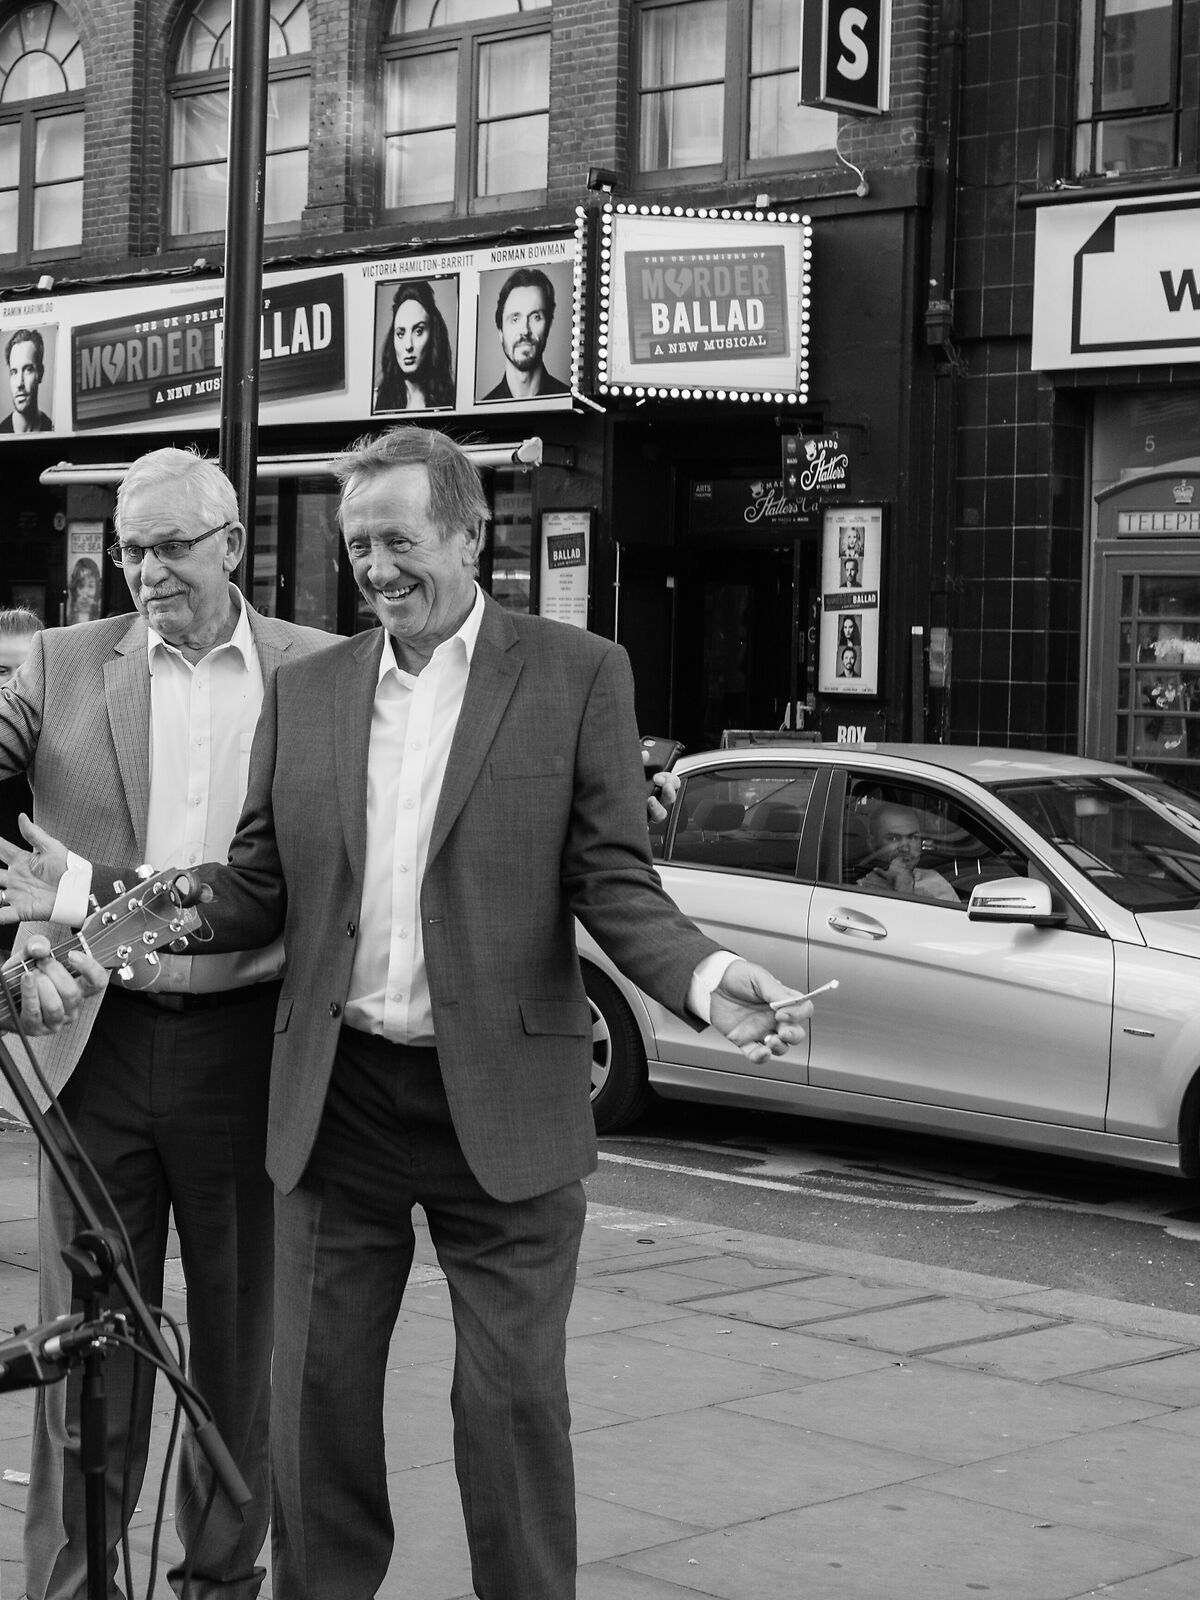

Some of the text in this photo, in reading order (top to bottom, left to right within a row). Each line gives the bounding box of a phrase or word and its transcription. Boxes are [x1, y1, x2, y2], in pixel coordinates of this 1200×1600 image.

[490, 243, 566, 263] NORMAN BOWMAN
[362, 255, 475, 278] VICTORIA HAMILTON-BARRITT
[3, 306, 22, 317] RAMIN
[134, 320, 157, 333] THE
[163, 316, 179, 328] UK
[185, 308, 224, 325] PREMI
[651, 298, 765, 335] BALLAD
[654, 335, 767, 355] A NEW MUSICAL
[155, 391, 164, 403] A
[167, 384, 193, 402] NEW
[817, 440, 838, 450] MADD
[1144, 435, 1155, 452] 5
[766, 480, 784, 489] MAD
[553, 548, 580, 561] BALLAD
[852, 594, 876, 604] BALLAD
[837, 725, 867, 743] BOX
